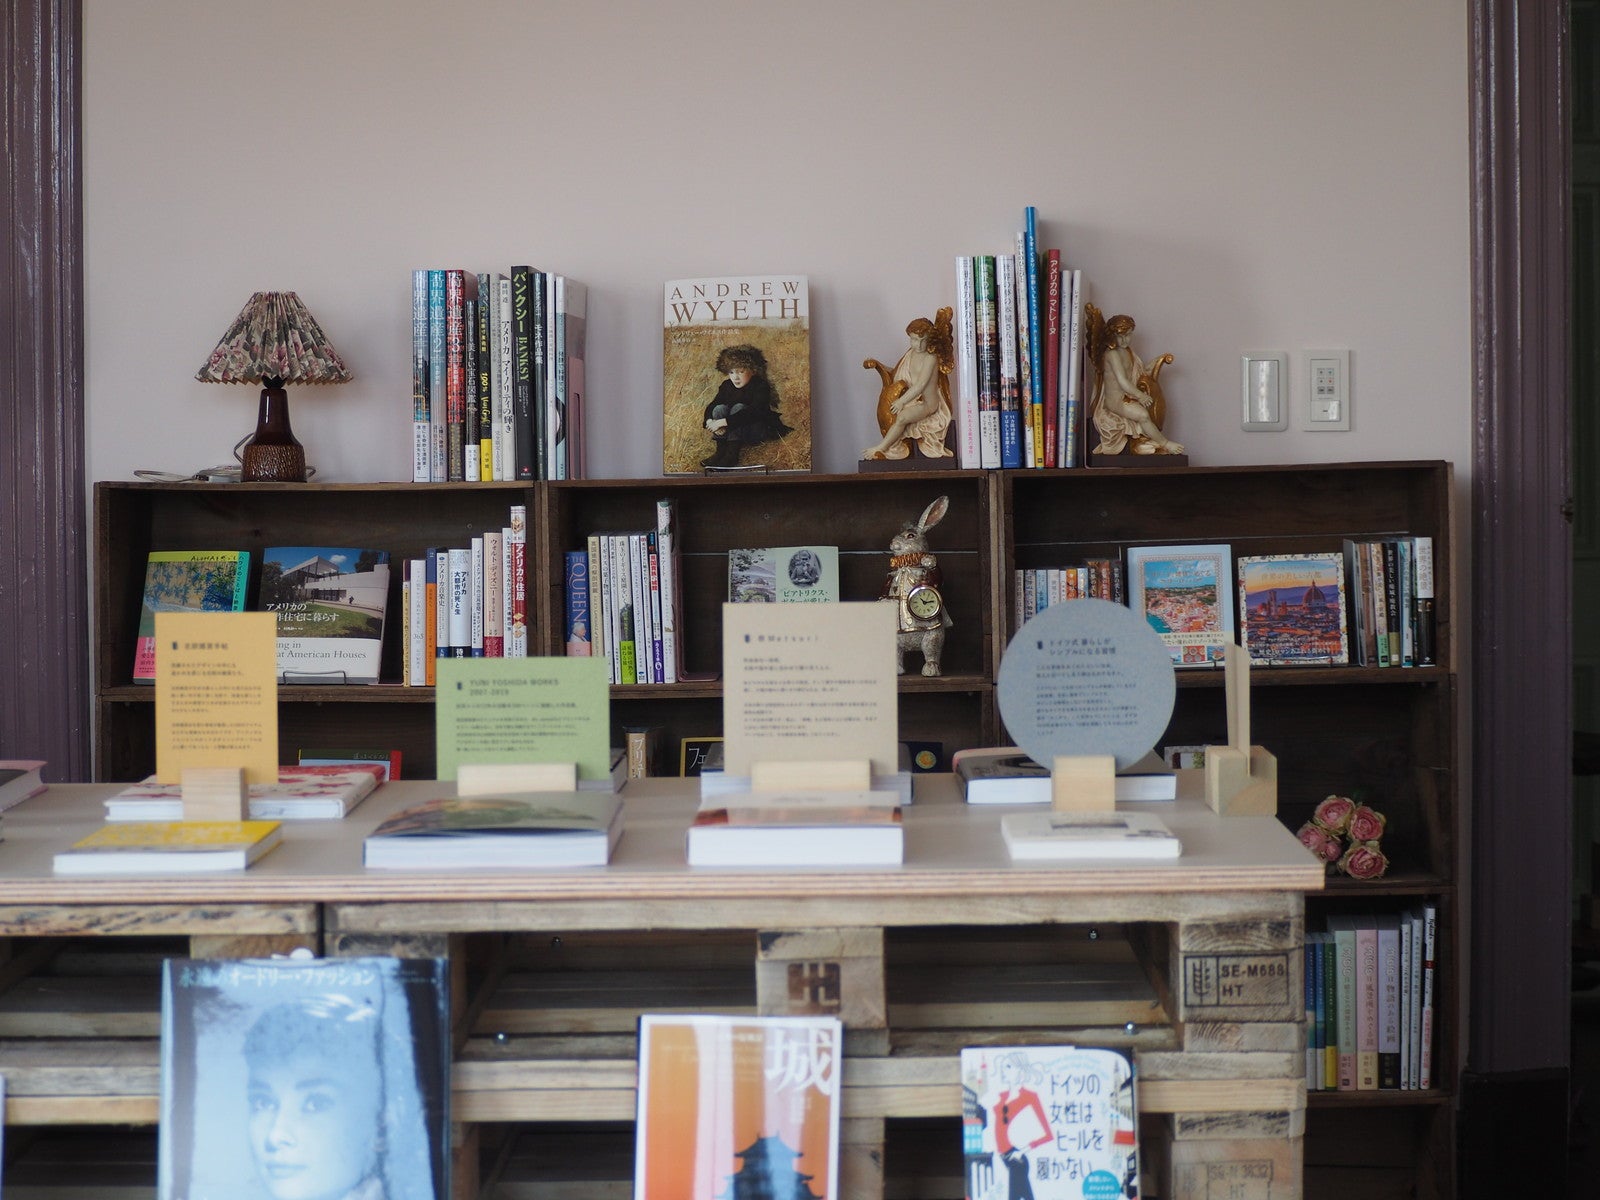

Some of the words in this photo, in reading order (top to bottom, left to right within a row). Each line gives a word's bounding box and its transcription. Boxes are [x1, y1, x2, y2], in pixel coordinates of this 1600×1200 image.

[1049, 260, 1058, 296] アメリカの
[513, 271, 527, 333] バンクシー
[670, 281, 799, 300] ANDREW
[671, 298, 800, 323] WYETH
[502, 320, 511, 355] アメリカ
[518, 336, 530, 381] BANKSY
[571, 555, 585, 564] THE
[515, 543, 525, 601] アメリカの住居
[569, 563, 588, 623] QUEEN
[266, 602, 308, 612] アメリカの
[277, 612, 340, 623] 作住宅に暮らす
[286, 650, 331, 659] American
[333, 650, 367, 659] Houses
[292, 641, 302, 649] in
[1221, 963, 1284, 979] SE-M688
[1221, 984, 1243, 998] HT
[763, 1028, 833, 1097] 城
[1050, 1073, 1101, 1096] ドイツの
[1050, 1102, 1093, 1125] 女性は
[1056, 1128, 1104, 1152] ヒールを
[1036, 1156, 1093, 1180] 履かない
